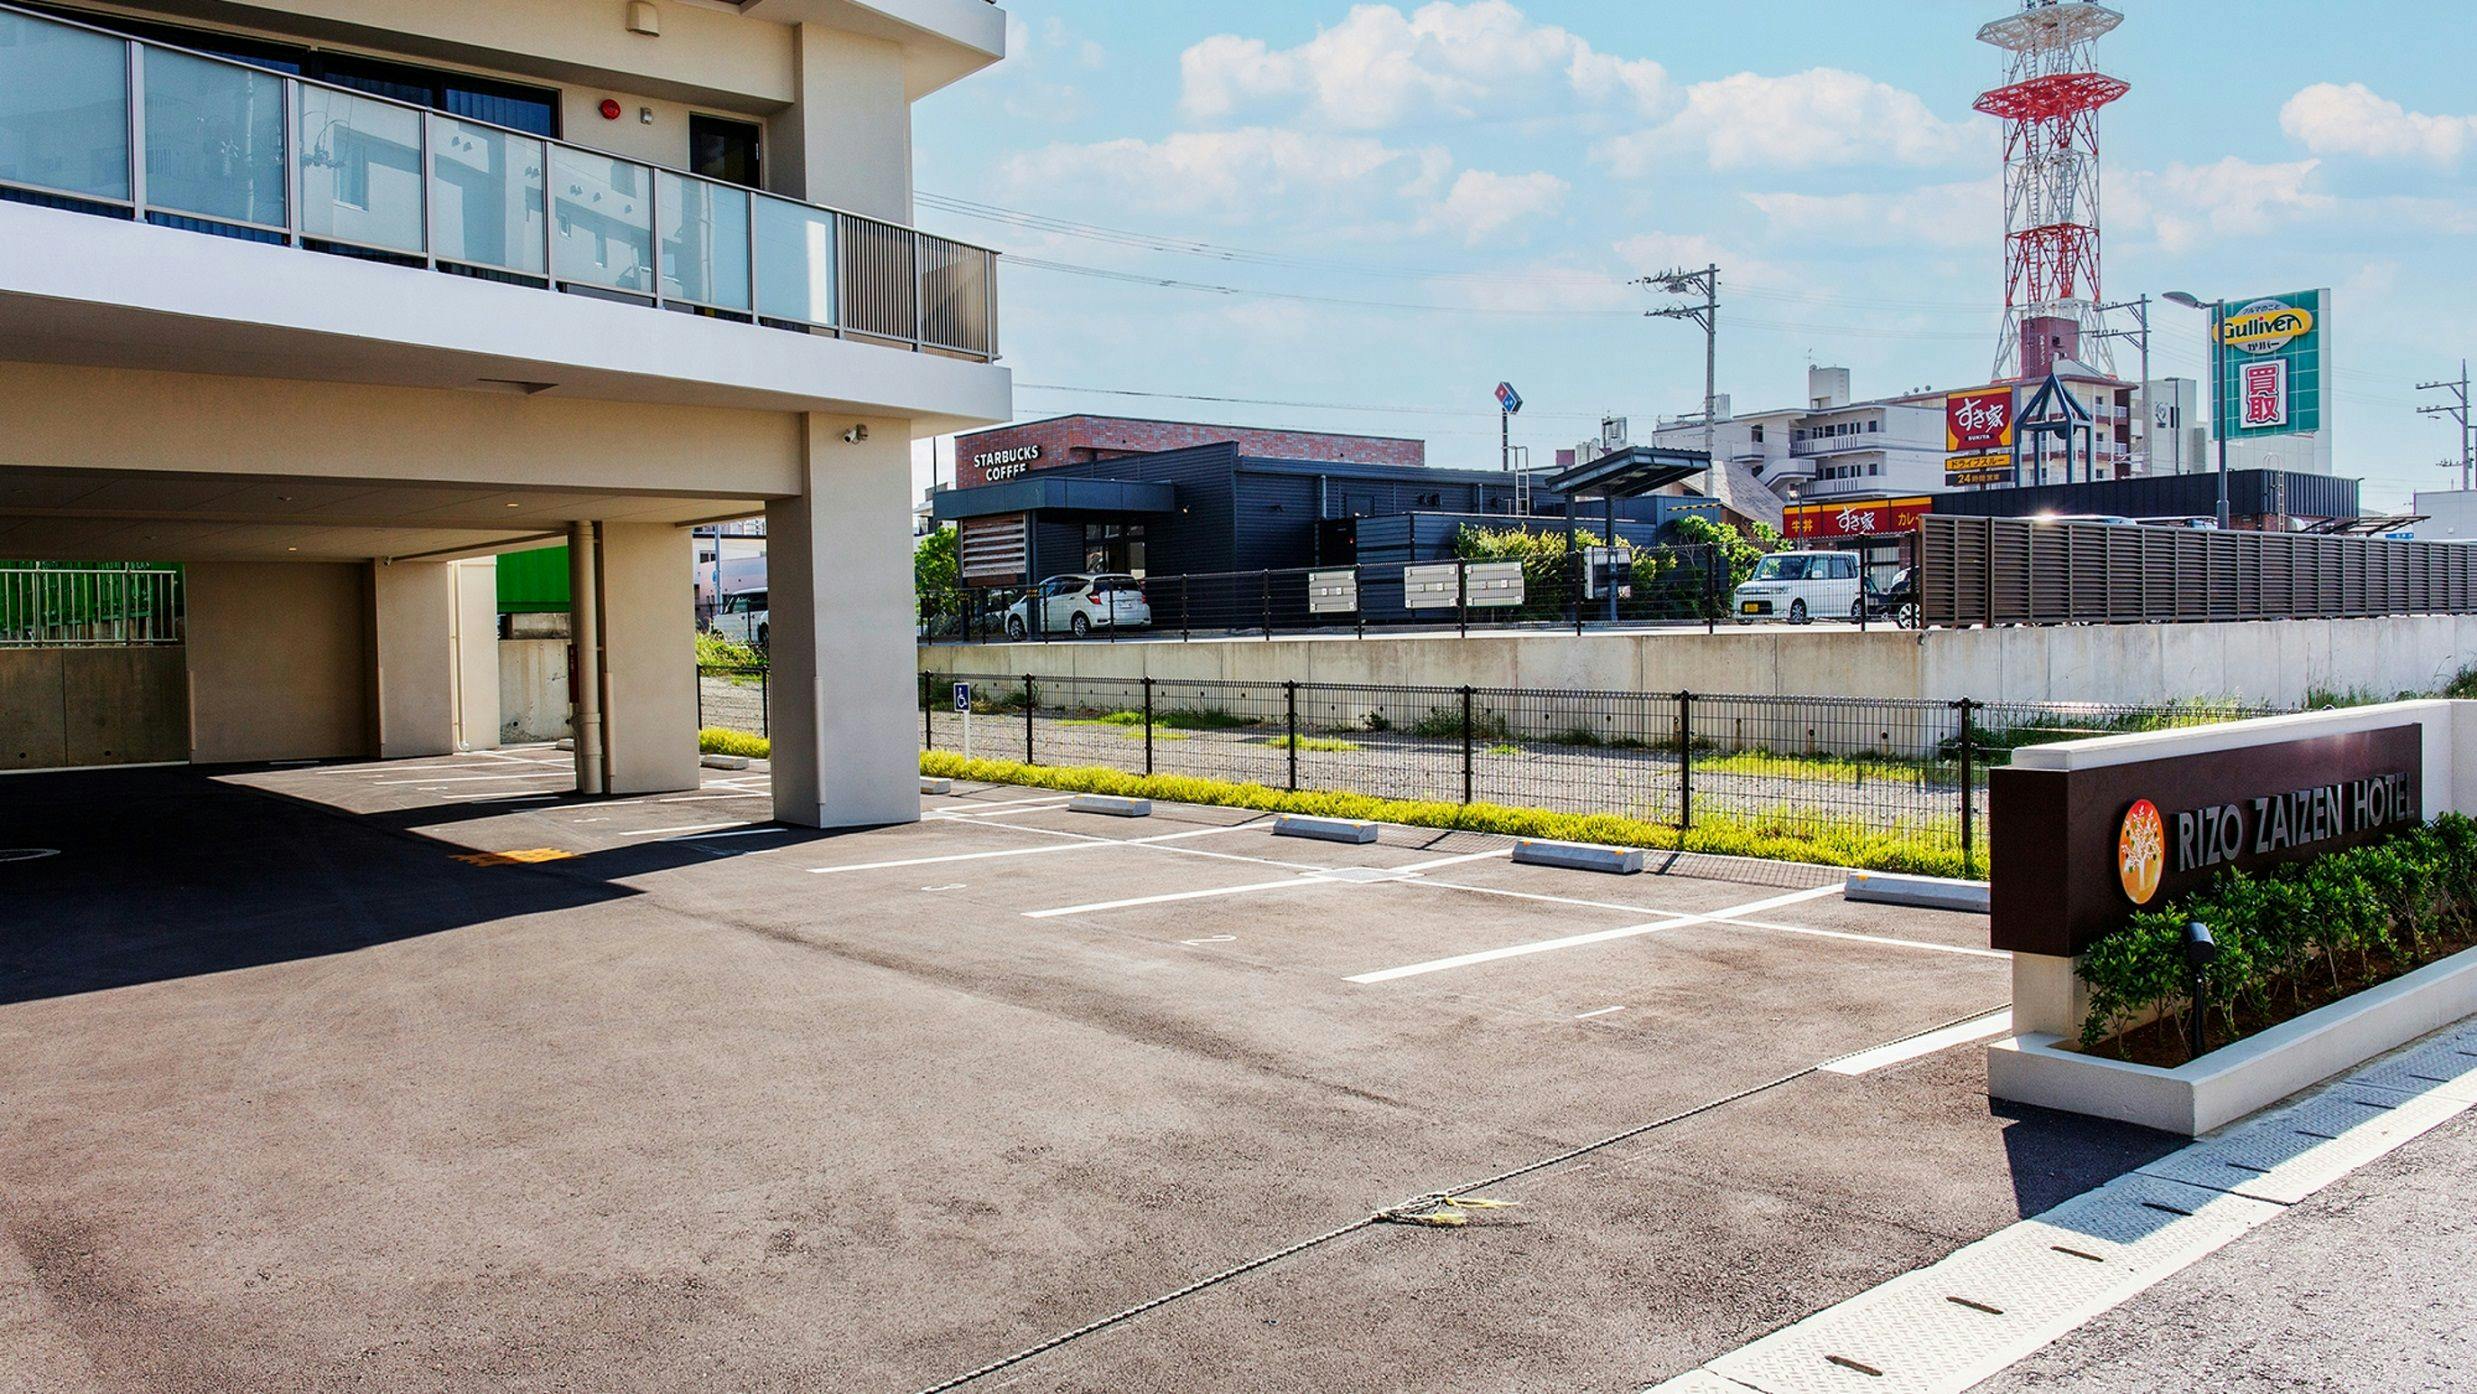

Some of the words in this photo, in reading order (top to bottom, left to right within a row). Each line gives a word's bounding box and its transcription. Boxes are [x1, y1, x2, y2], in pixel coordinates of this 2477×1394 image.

[2224, 314, 2302, 338] Gulliver
[2247, 364, 2279, 422] 買取
[1955, 398, 2004, 433] すき家
[974, 445, 1039, 468] STARBUCKS
[1951, 457, 2005, 468] ドライブスルー
[986, 463, 1026, 481] COFFEE
[1791, 518, 1814, 533] 牛丼
[1836, 505, 1875, 533] すき家
[1897, 512, 1919, 527] カレ
[2178, 803, 2243, 872] RIZO
[2254, 783, 2343, 855] ZAIZEN
[2353, 773, 2415, 832] HOTEL
